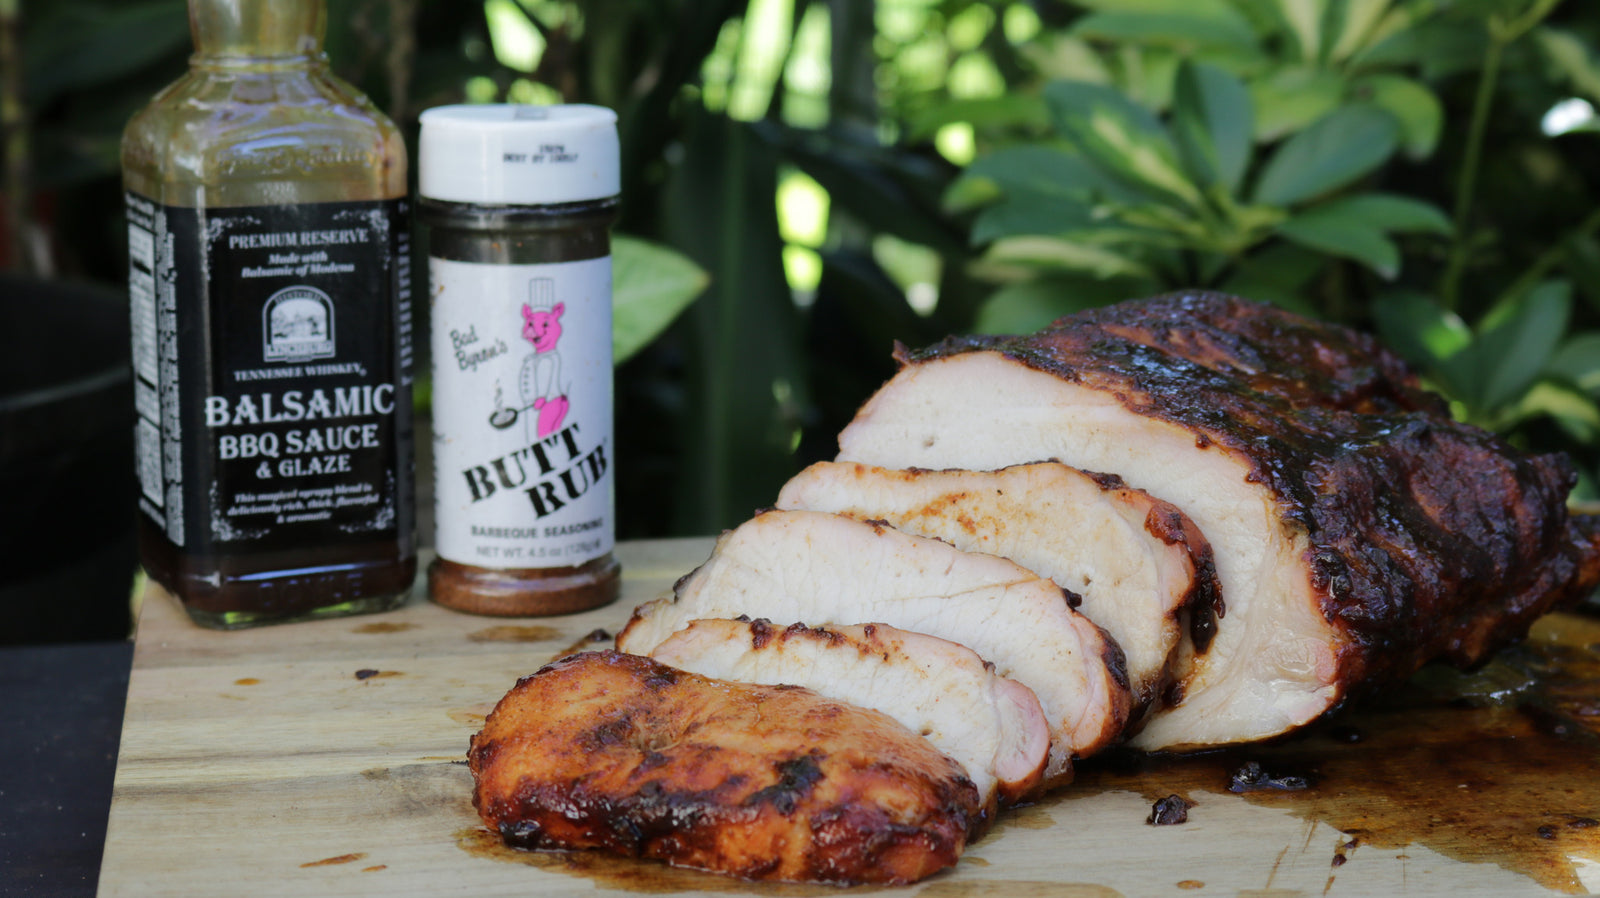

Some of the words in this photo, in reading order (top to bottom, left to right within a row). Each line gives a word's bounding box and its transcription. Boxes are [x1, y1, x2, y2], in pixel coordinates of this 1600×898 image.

[229, 232, 298, 250] PREMIUM
[300, 228, 369, 246] RESERVE
[269, 253, 299, 265] Made
[300, 251, 328, 263] with
[241, 265, 293, 279] Balsamic
[296, 264, 309, 277] of
[310, 262, 355, 274] Modena
[450, 324, 479, 351] Bad
[454, 337, 508, 372] Byron's
[234, 367, 302, 382] TENNESSEE
[204, 383, 396, 427] BALSAMIC
[219, 432, 280, 459] BBQ
[285, 423, 380, 454] SAUCE
[256, 460, 273, 479] &
[278, 454, 352, 477] GLAZE
[462, 422, 581, 503] BUTT
[234, 493, 256, 503] This
[257, 489, 298, 503] magical
[334, 483, 363, 495] blend
[363, 483, 373, 493] is
[524, 444, 608, 519] RUB
[227, 502, 281, 517] deliciously
[282, 500, 305, 511] rich,
[335, 493, 380, 508] flavorful
[286, 511, 332, 523] aromatic
[471, 525, 538, 539] BARBEQUE
[476, 546, 500, 558] NET
[502, 547, 523, 559] WT.
[529, 546, 546, 558] 4.5
